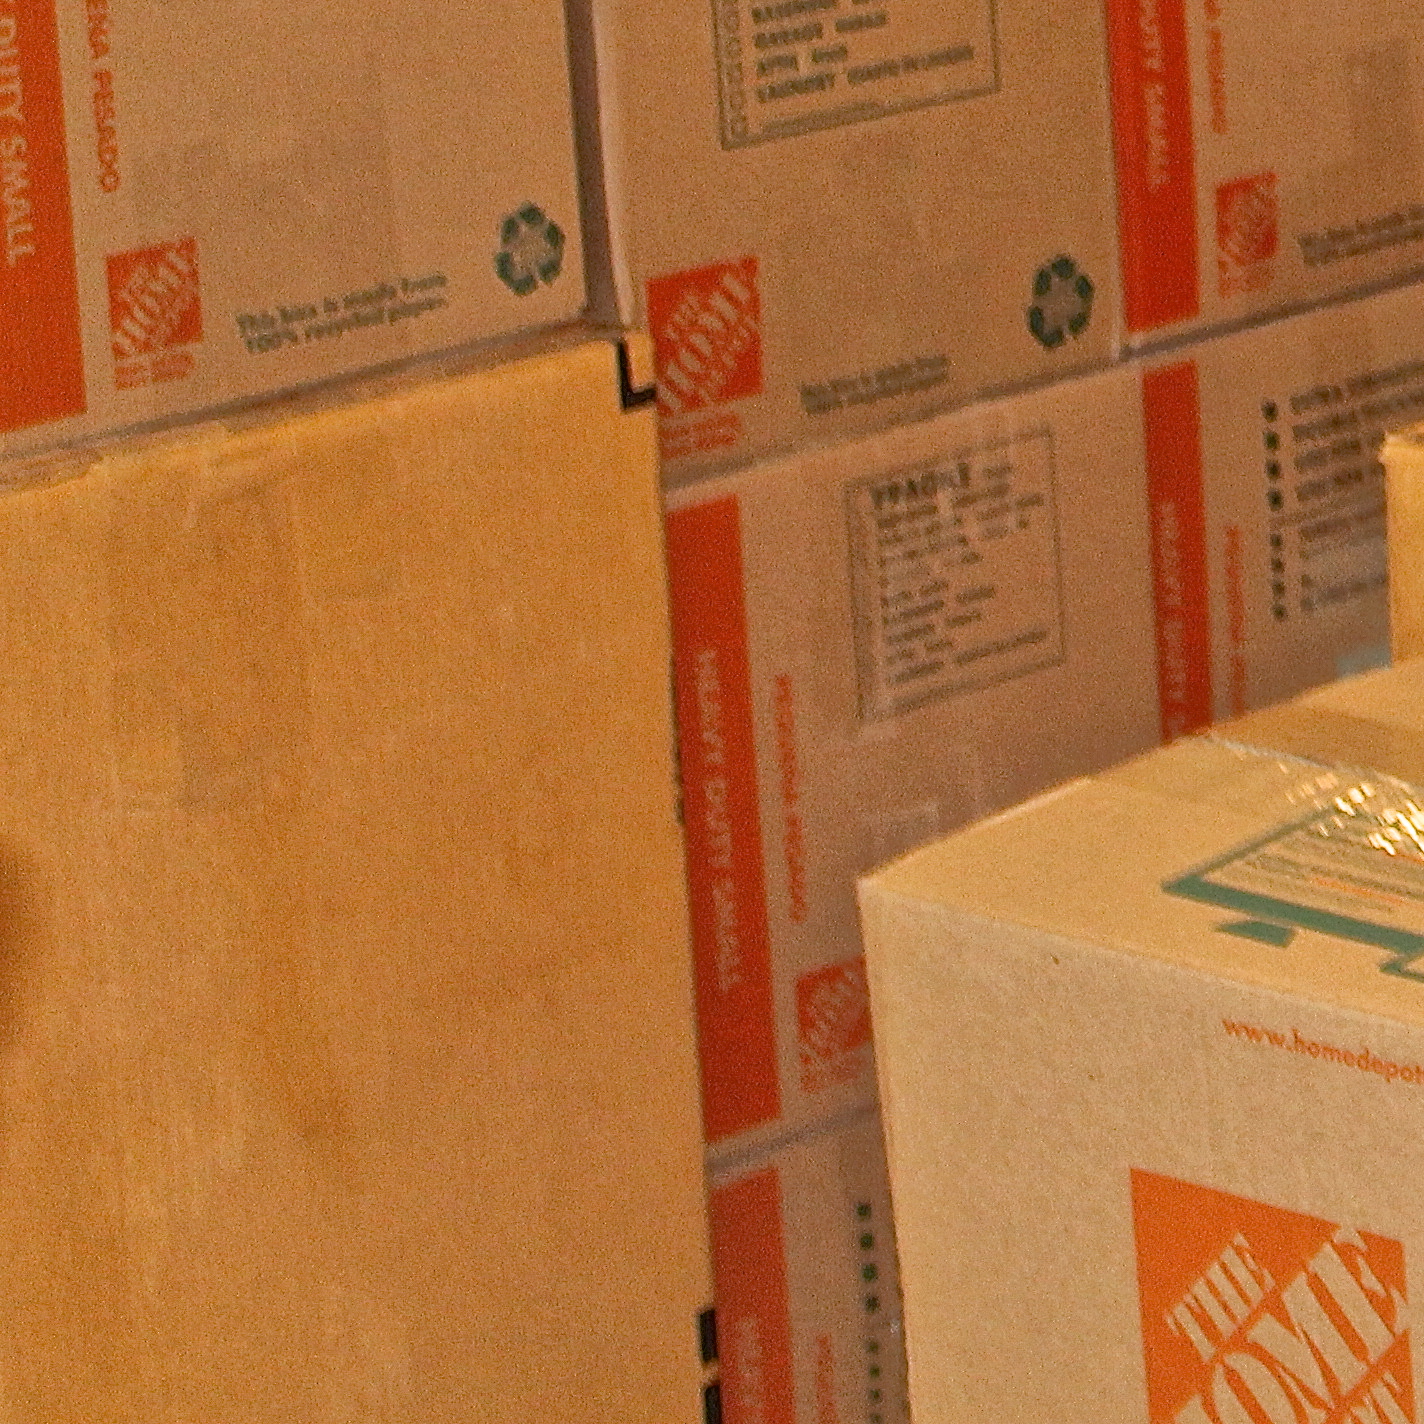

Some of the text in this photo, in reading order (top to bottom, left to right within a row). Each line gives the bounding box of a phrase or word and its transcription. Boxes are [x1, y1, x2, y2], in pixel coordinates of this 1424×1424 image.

[2, 134, 36, 268] SMALL
[1163, 1230, 1276, 1363] THE
[1172, 1220, 1409, 1424] OME
